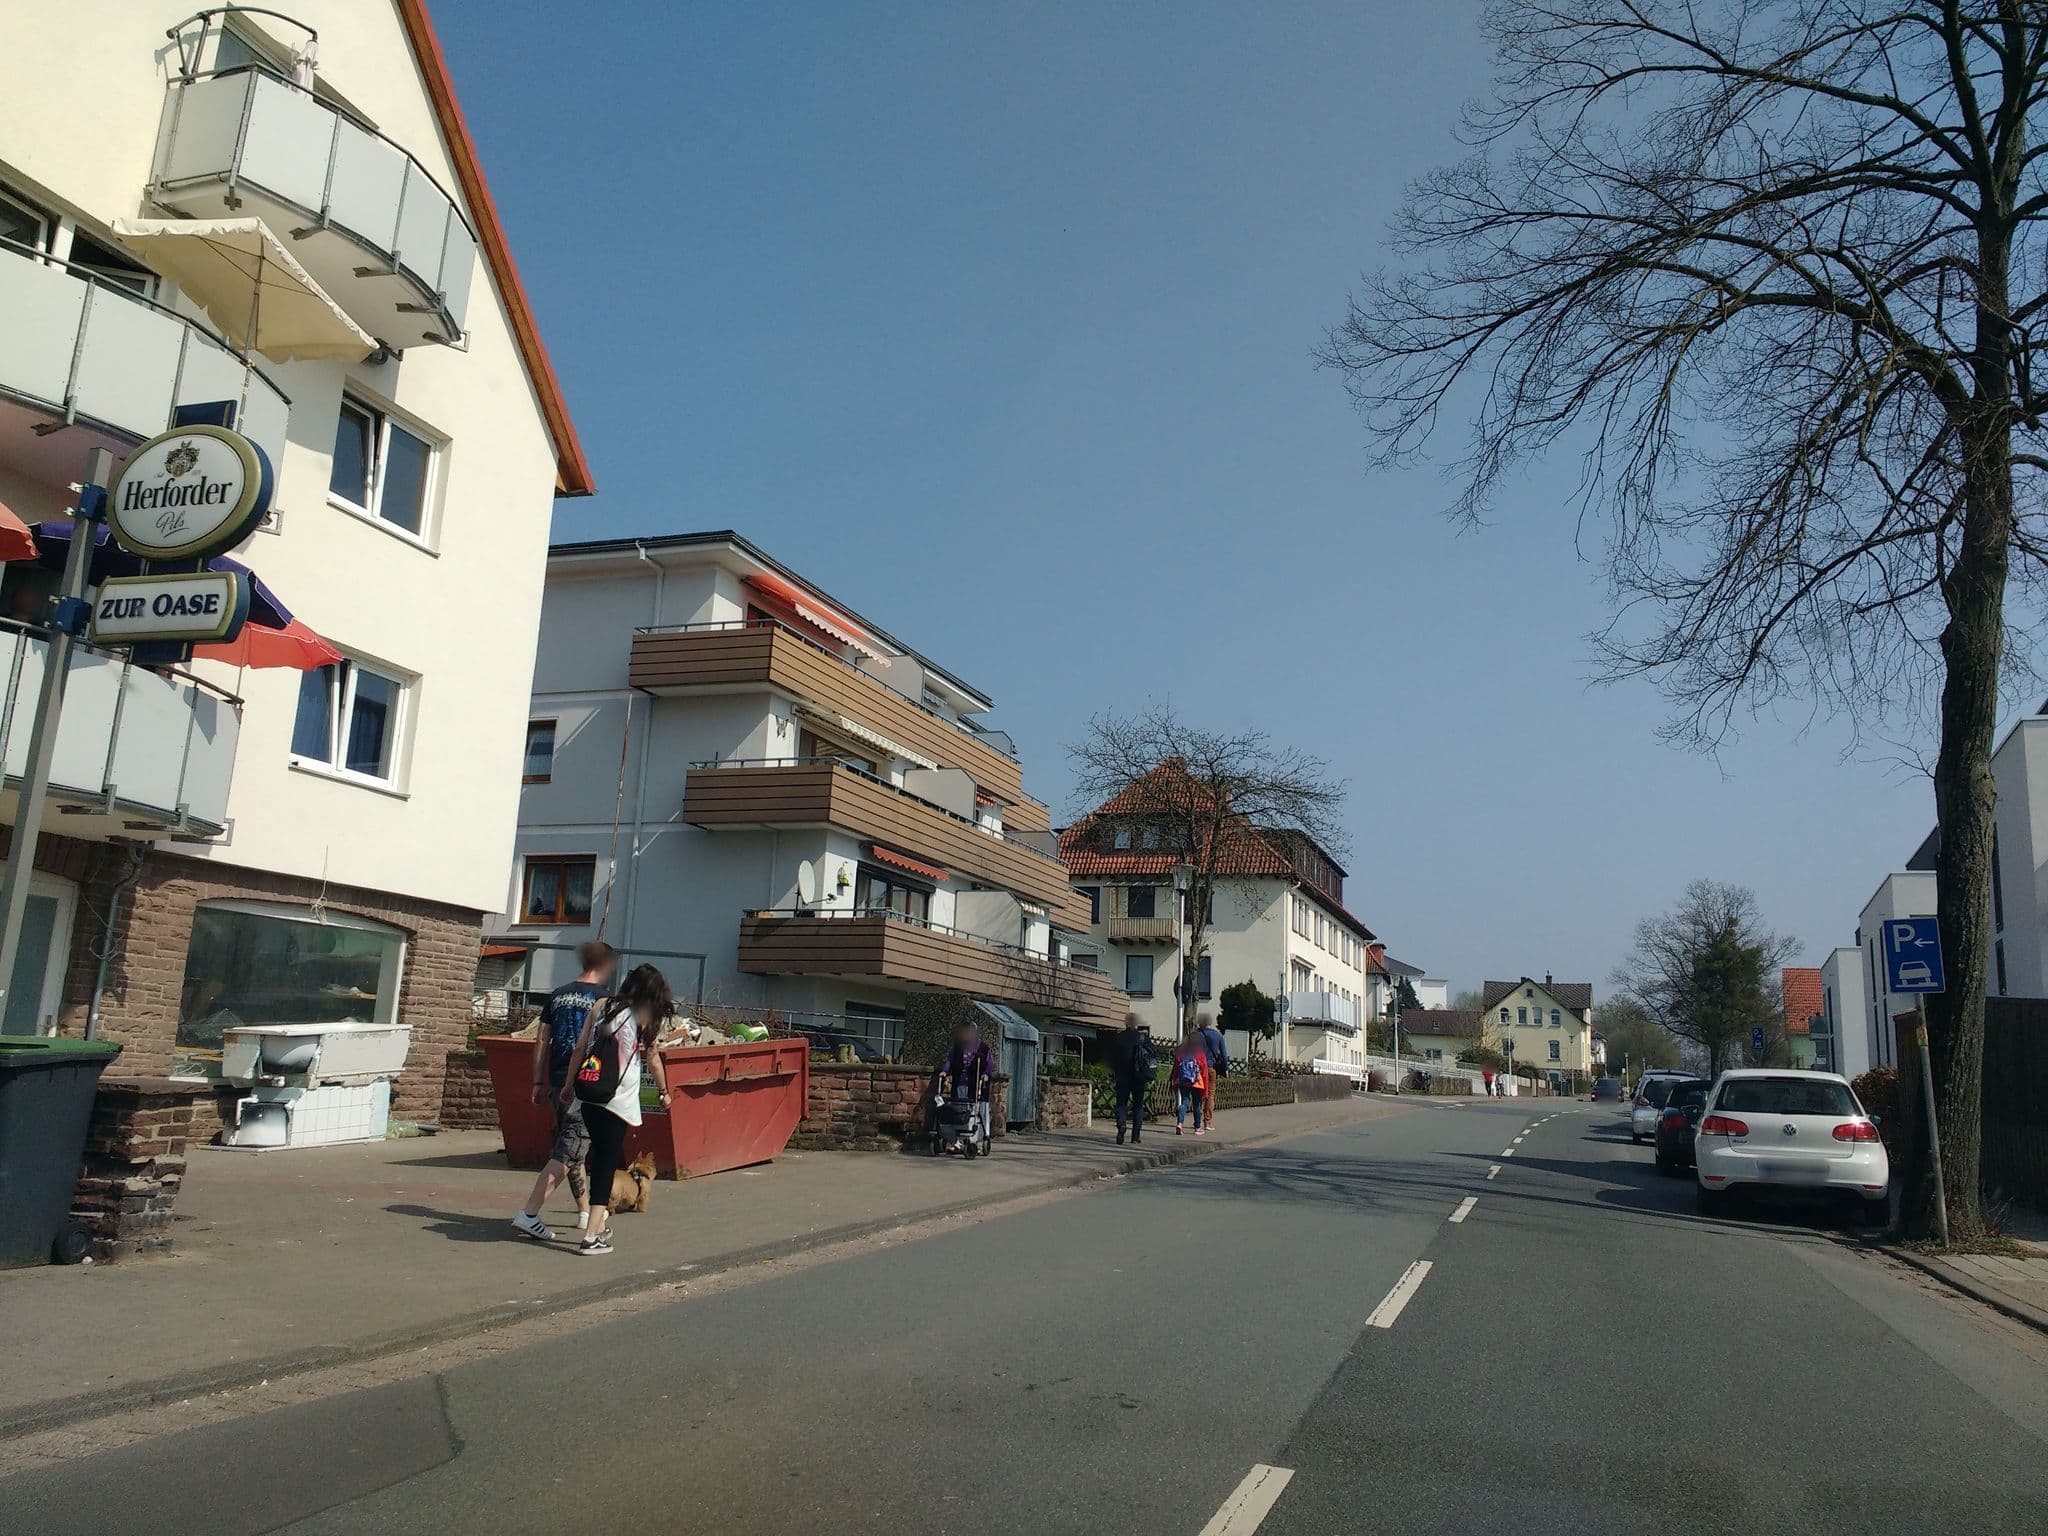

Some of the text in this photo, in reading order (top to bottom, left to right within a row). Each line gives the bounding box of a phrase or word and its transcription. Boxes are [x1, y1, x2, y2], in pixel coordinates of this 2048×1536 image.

[123, 476, 233, 511] Herforder
[156, 510, 186, 533] Pils
[99, 594, 219, 619] ZUR OASE
[1893, 924, 1915, 953] P
